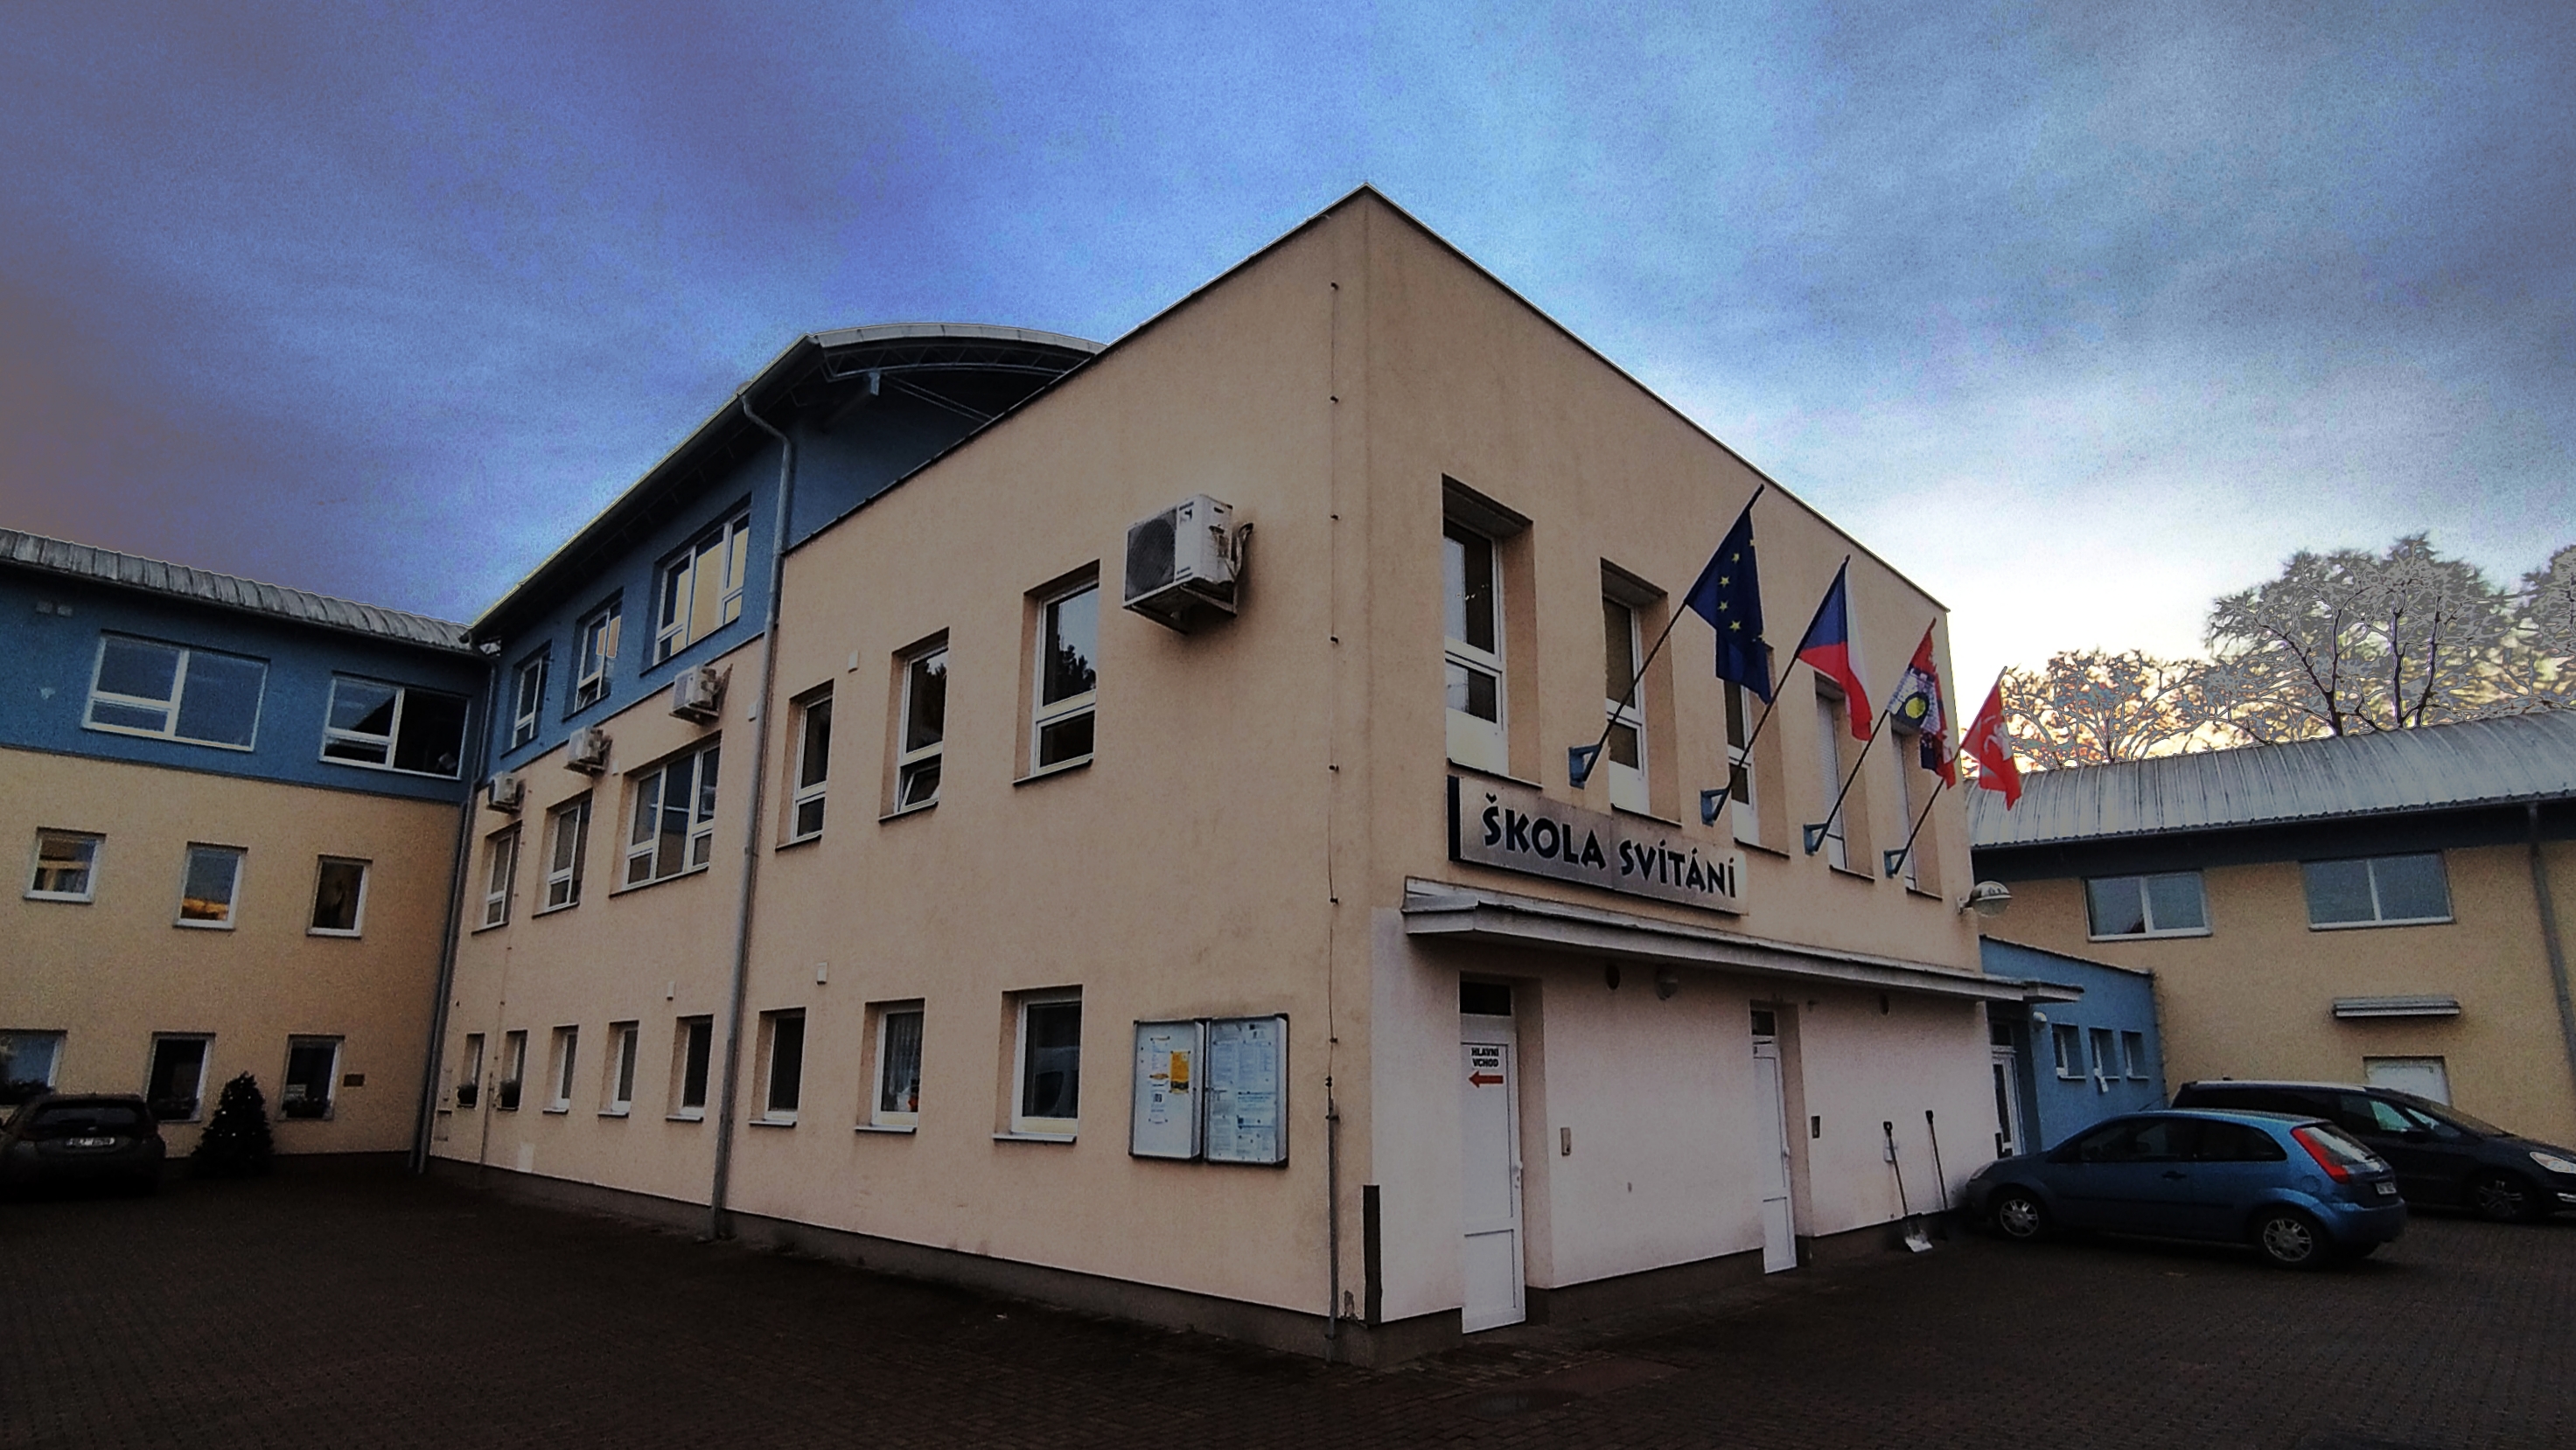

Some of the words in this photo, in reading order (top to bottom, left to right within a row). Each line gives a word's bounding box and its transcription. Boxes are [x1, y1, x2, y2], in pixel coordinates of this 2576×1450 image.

[1482, 791, 1607, 871] ŠKOLA
[1618, 839, 1736, 898] SVÍTÁNÍ
[1472, 1058, 1499, 1067] VCHOD
